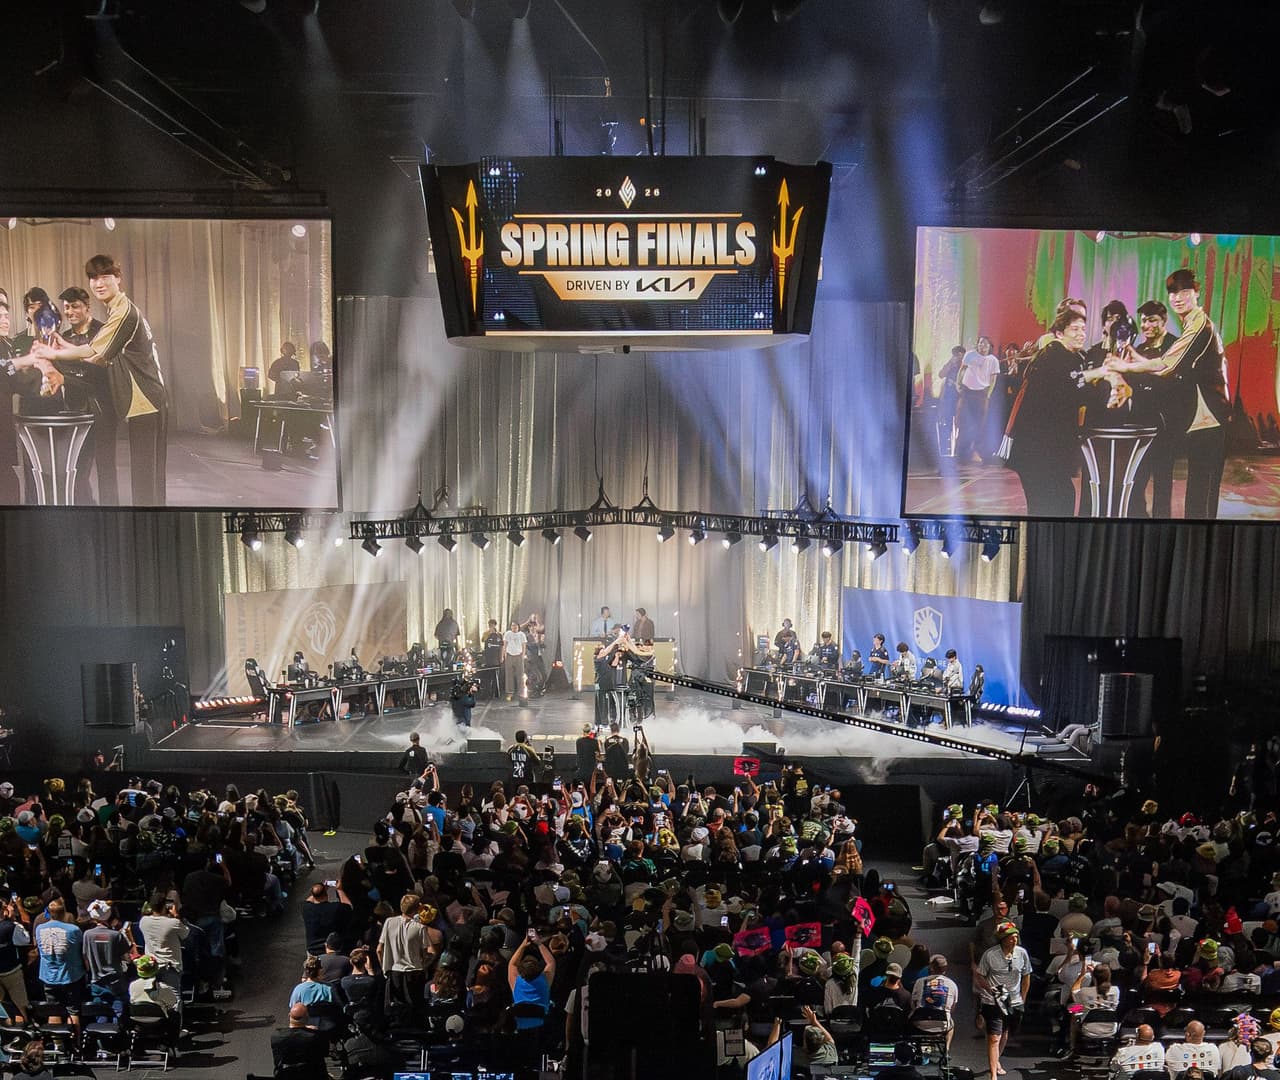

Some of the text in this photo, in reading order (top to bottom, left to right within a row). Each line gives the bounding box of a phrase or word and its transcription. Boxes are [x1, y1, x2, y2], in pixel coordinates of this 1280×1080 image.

[500, 222, 757, 267] SPRING FINALS
[566, 277, 696, 292] DRIVEN BY KIA
